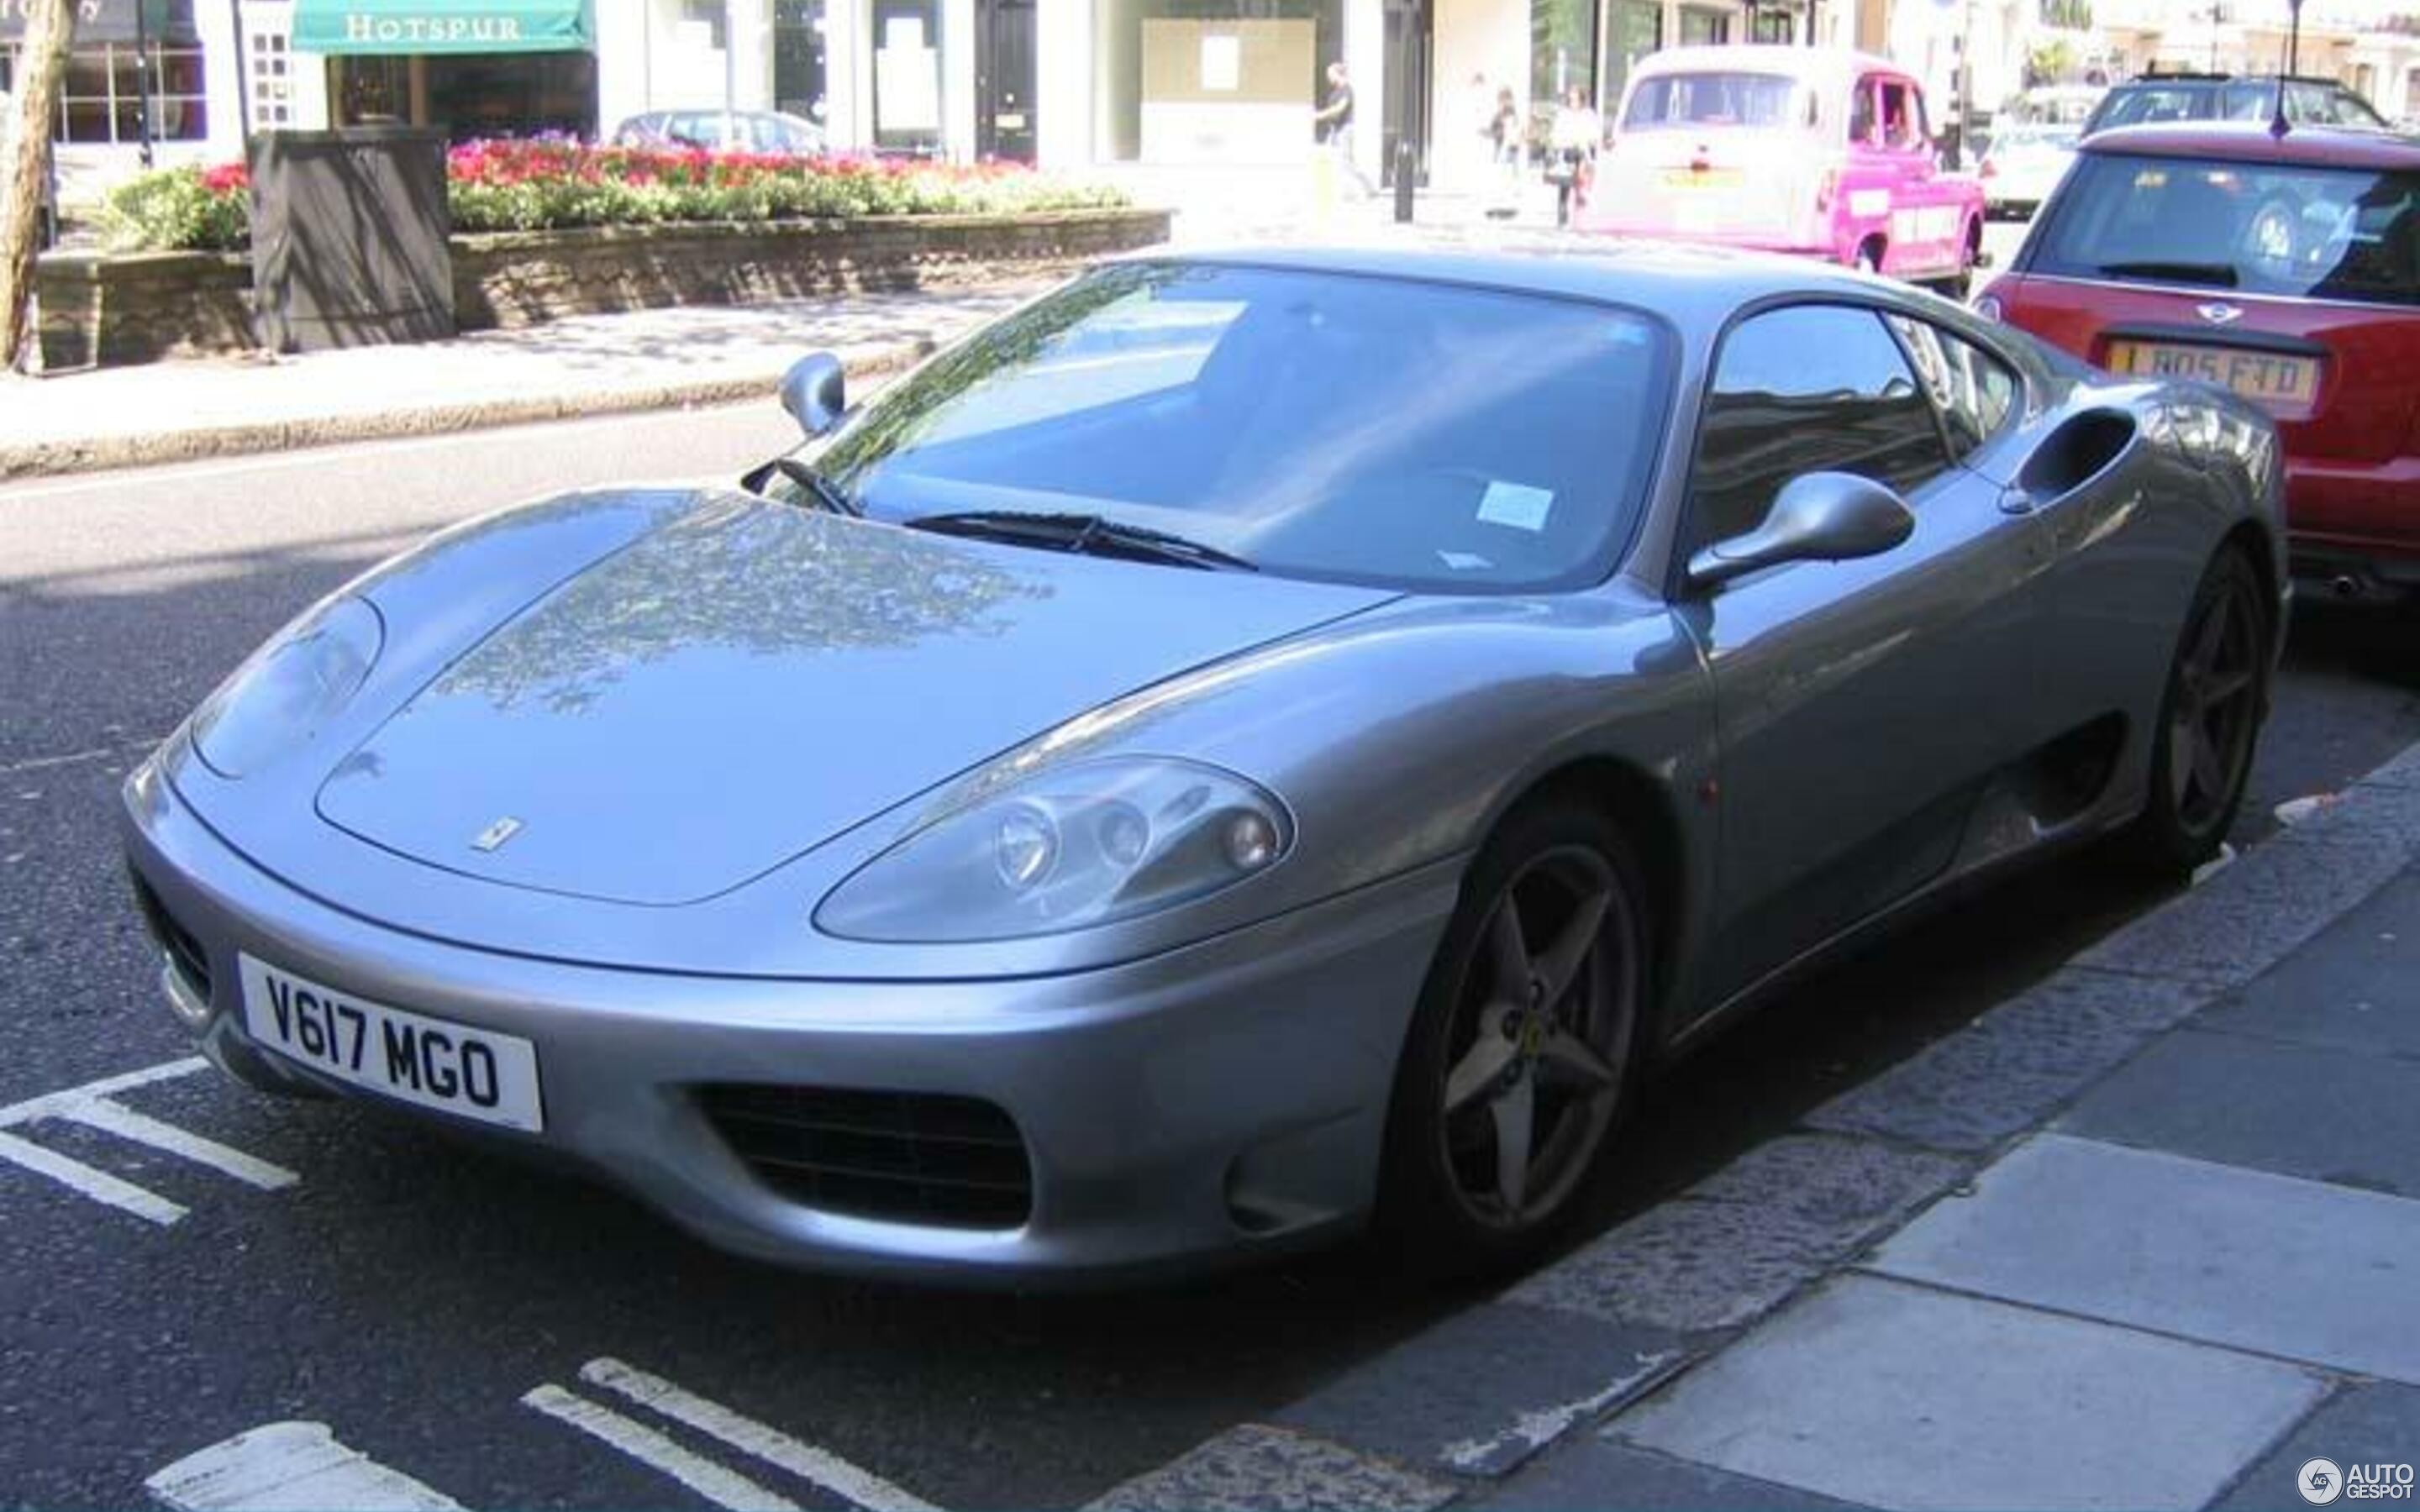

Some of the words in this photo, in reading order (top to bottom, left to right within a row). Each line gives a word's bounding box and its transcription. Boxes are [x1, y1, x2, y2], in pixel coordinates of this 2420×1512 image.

[346, 14, 521, 41] HOTSPUR
[265, 975, 366, 1071] V617
[383, 1018, 499, 1108] MGO
